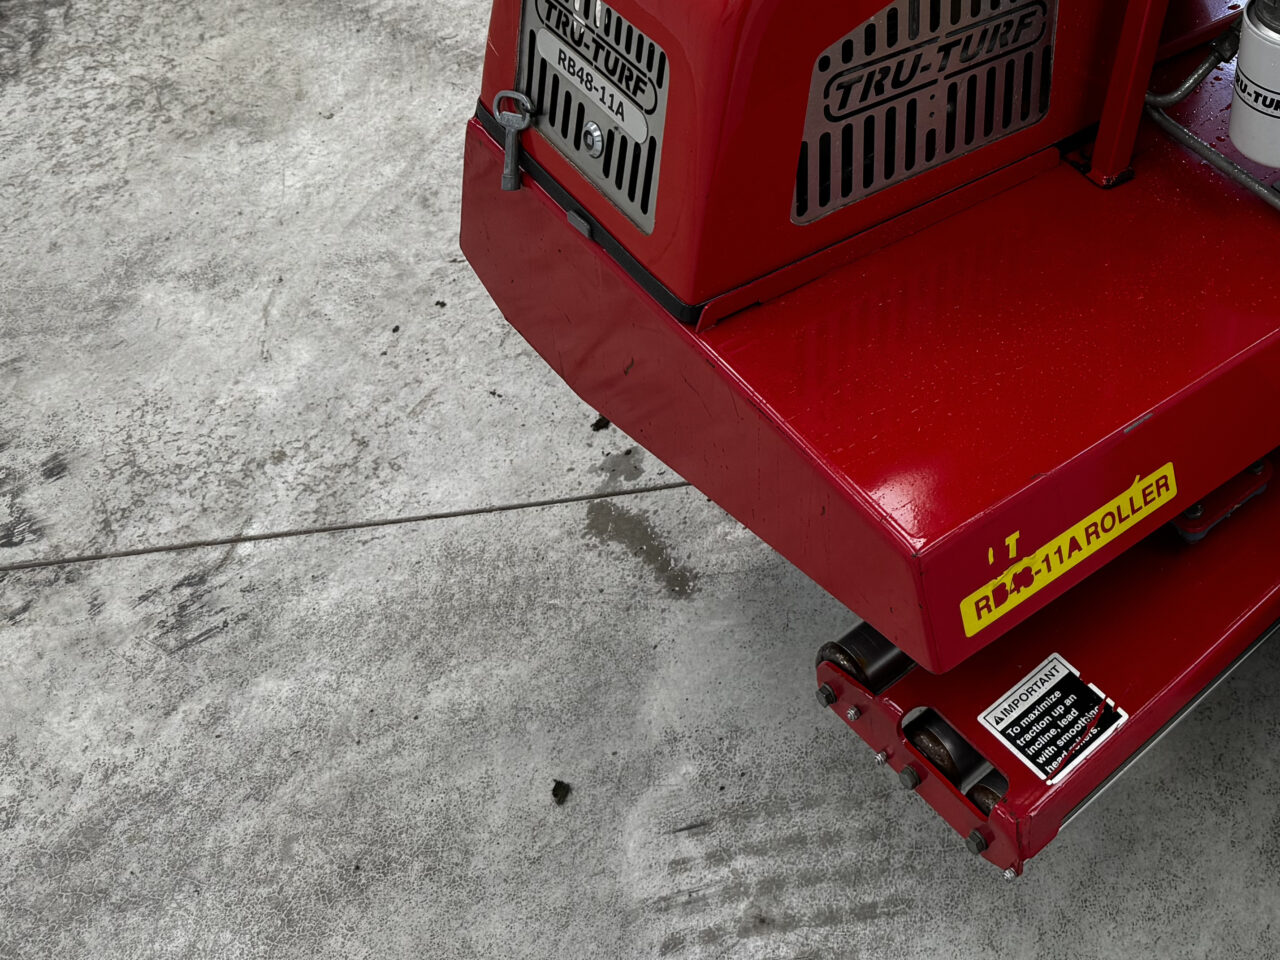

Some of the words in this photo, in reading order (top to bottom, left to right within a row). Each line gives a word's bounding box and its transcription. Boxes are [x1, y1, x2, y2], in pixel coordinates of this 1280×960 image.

[558, 47, 625, 122] RB48-11A
[835, 9, 1038, 112] TRU-TURF
[1084, 473, 1171, 546] ROLLER
[1000, 664, 1061, 718] IMPORTANT
[1006, 724, 1021, 738] To
[1020, 690, 1062, 728] maximize
[1016, 715, 1052, 747] traction
[1050, 704, 1065, 717] up
[1063, 694, 1077, 706] an
[1025, 728, 1061, 756] incline,
[1057, 707, 1079, 728] lead
[1036, 745, 1058, 764] with
